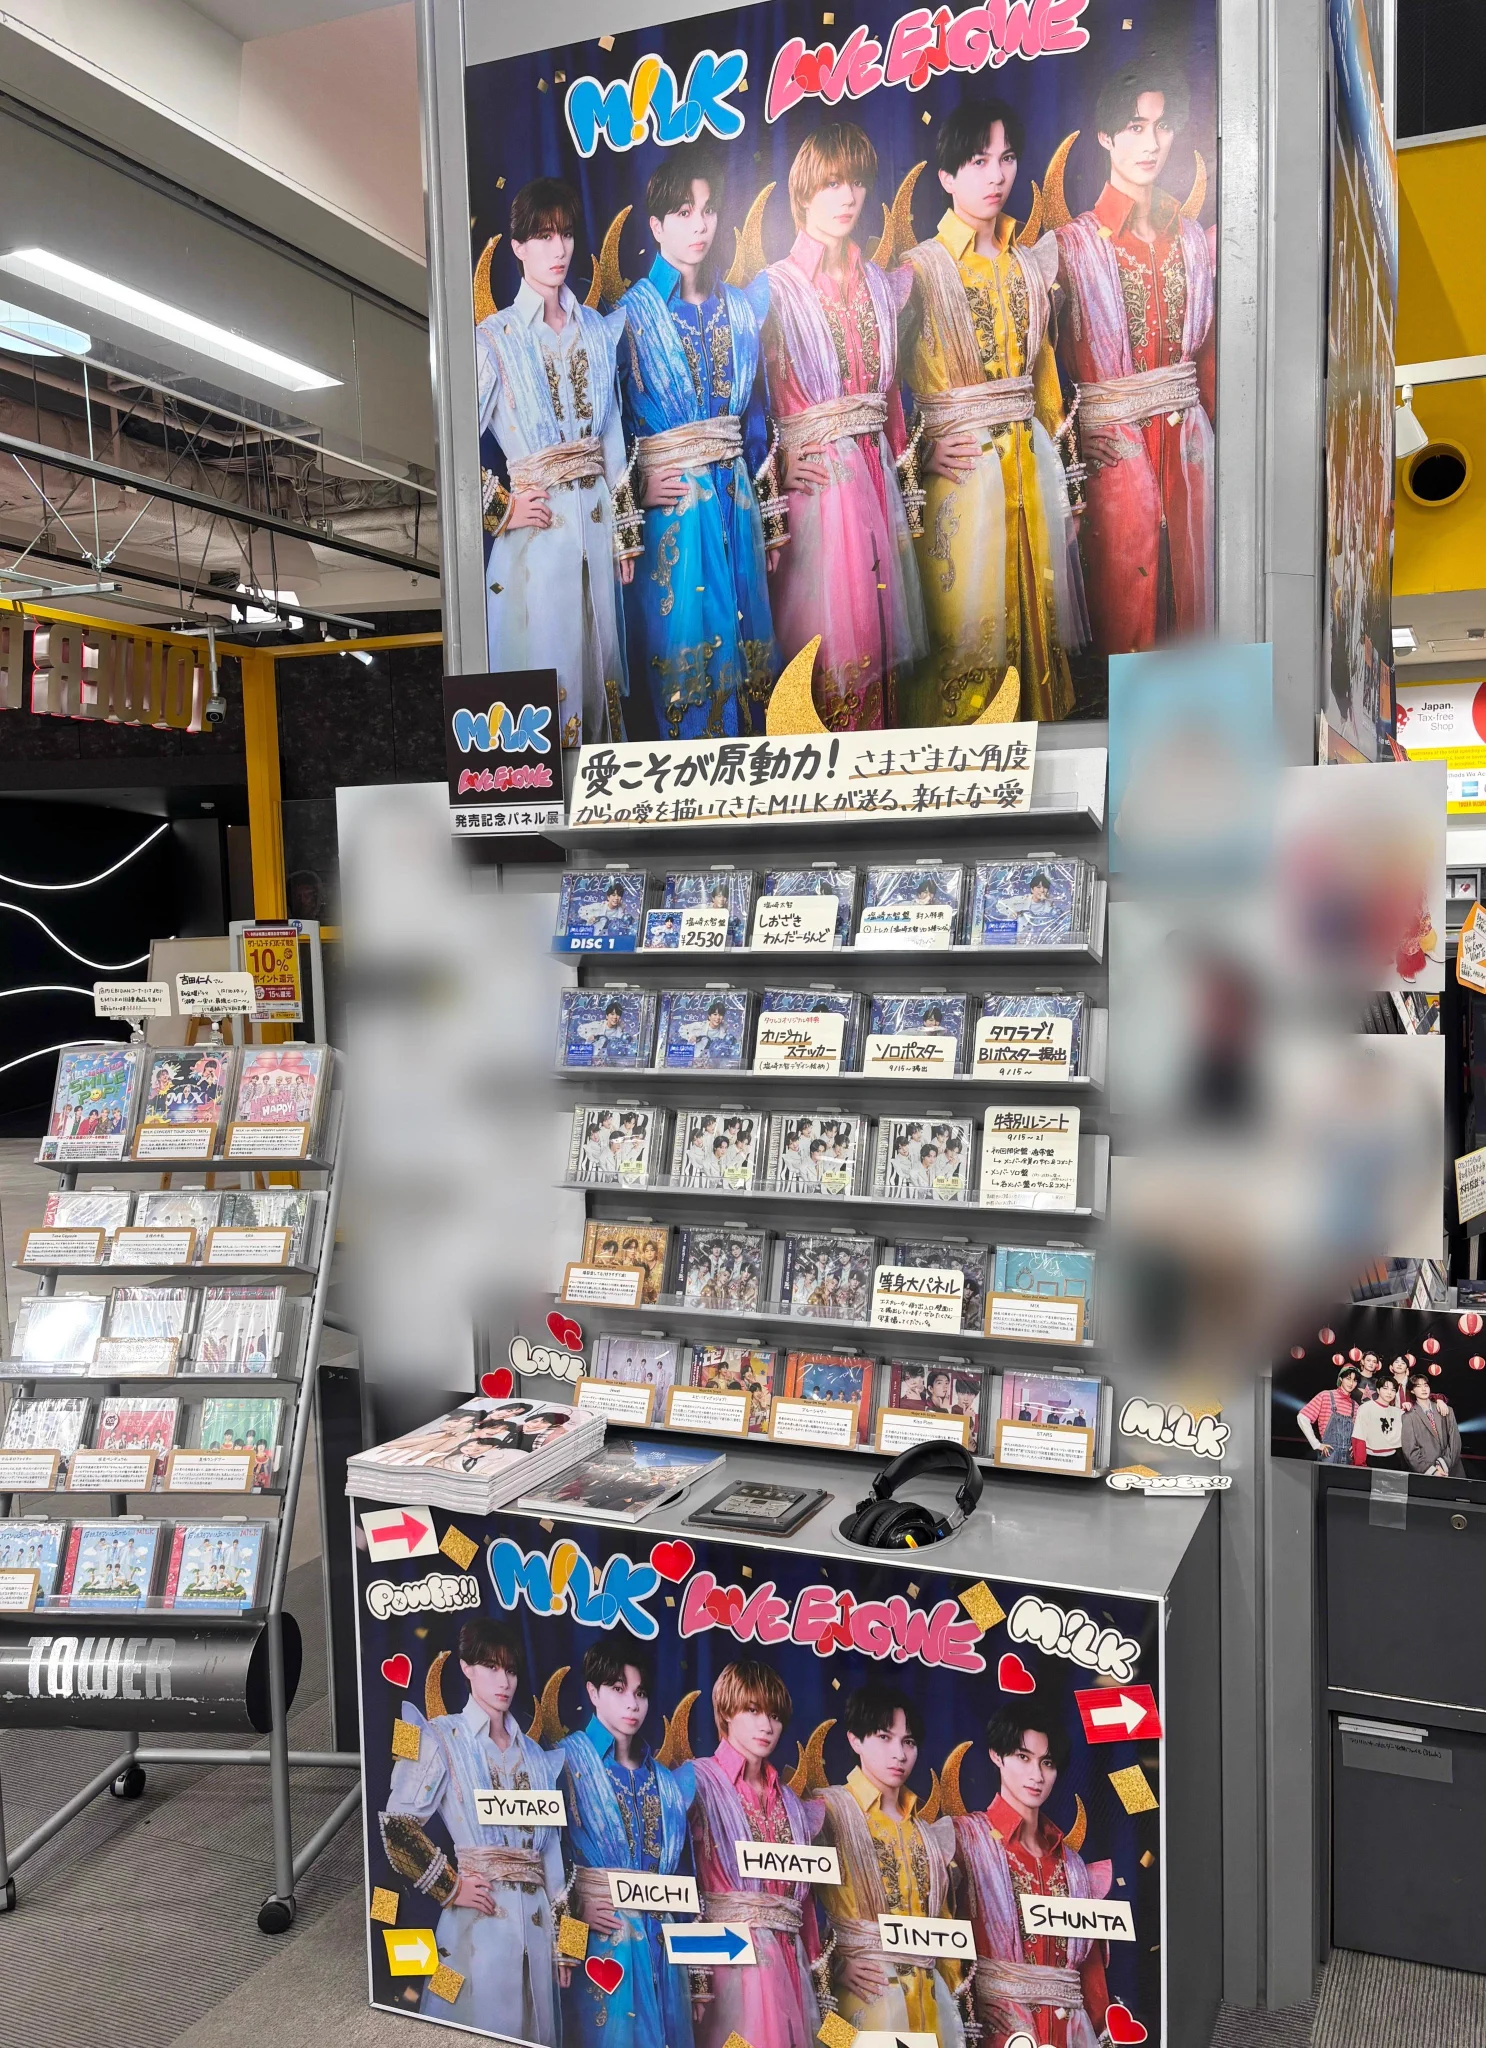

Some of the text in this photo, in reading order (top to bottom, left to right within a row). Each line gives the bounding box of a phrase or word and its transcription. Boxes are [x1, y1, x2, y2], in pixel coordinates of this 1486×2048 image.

[765, 25, 882, 124] LOVE
[1417, 713, 1454, 722] Tax-free
[1421, 702, 1454, 712] Japan.
[1430, 722, 1454, 731] Shop
[581, 739, 1031, 798] 愛こそが原動力! さまざまな角度
[458, 768, 493, 794] LOVE
[455, 811, 559, 828] 発売記念パネル展
[759, 913, 801, 928] しおざき
[571, 938, 615, 949] DISC 1
[763, 928, 830, 945] わんだーらんど
[250, 948, 289, 973] 10%
[254, 975, 294, 984] ポイント還元
[764, 1016, 820, 1024] タワレコオリジナル特典
[990, 1021, 1054, 1041] タワラブ!
[787, 1045, 837, 1058] ステッカー
[876, 1041, 943, 1060] ソロポスター
[69, 1071, 126, 1094] SMILE
[994, 1112, 1069, 1130] 特別レシート
[879, 1272, 960, 1294] 等身大パネル
[508, 1336, 587, 1385] LOVE
[1119, 1397, 1231, 1460] M!LK
[1106, 1473, 1232, 1490] POWER!!
[366, 1573, 481, 1619] POWER!!
[679, 1571, 795, 1643] LOVE
[1007, 1595, 1141, 1683] M!LK
[28, 1636, 177, 1699] TOWER
[478, 1797, 560, 1817] JYUTARO
[743, 1850, 832, 1873] HAYATO
[617, 1880, 690, 1904] DAICHI
[1029, 1905, 1127, 1931] SHUNTA
[886, 1921, 968, 1949] JINTO
